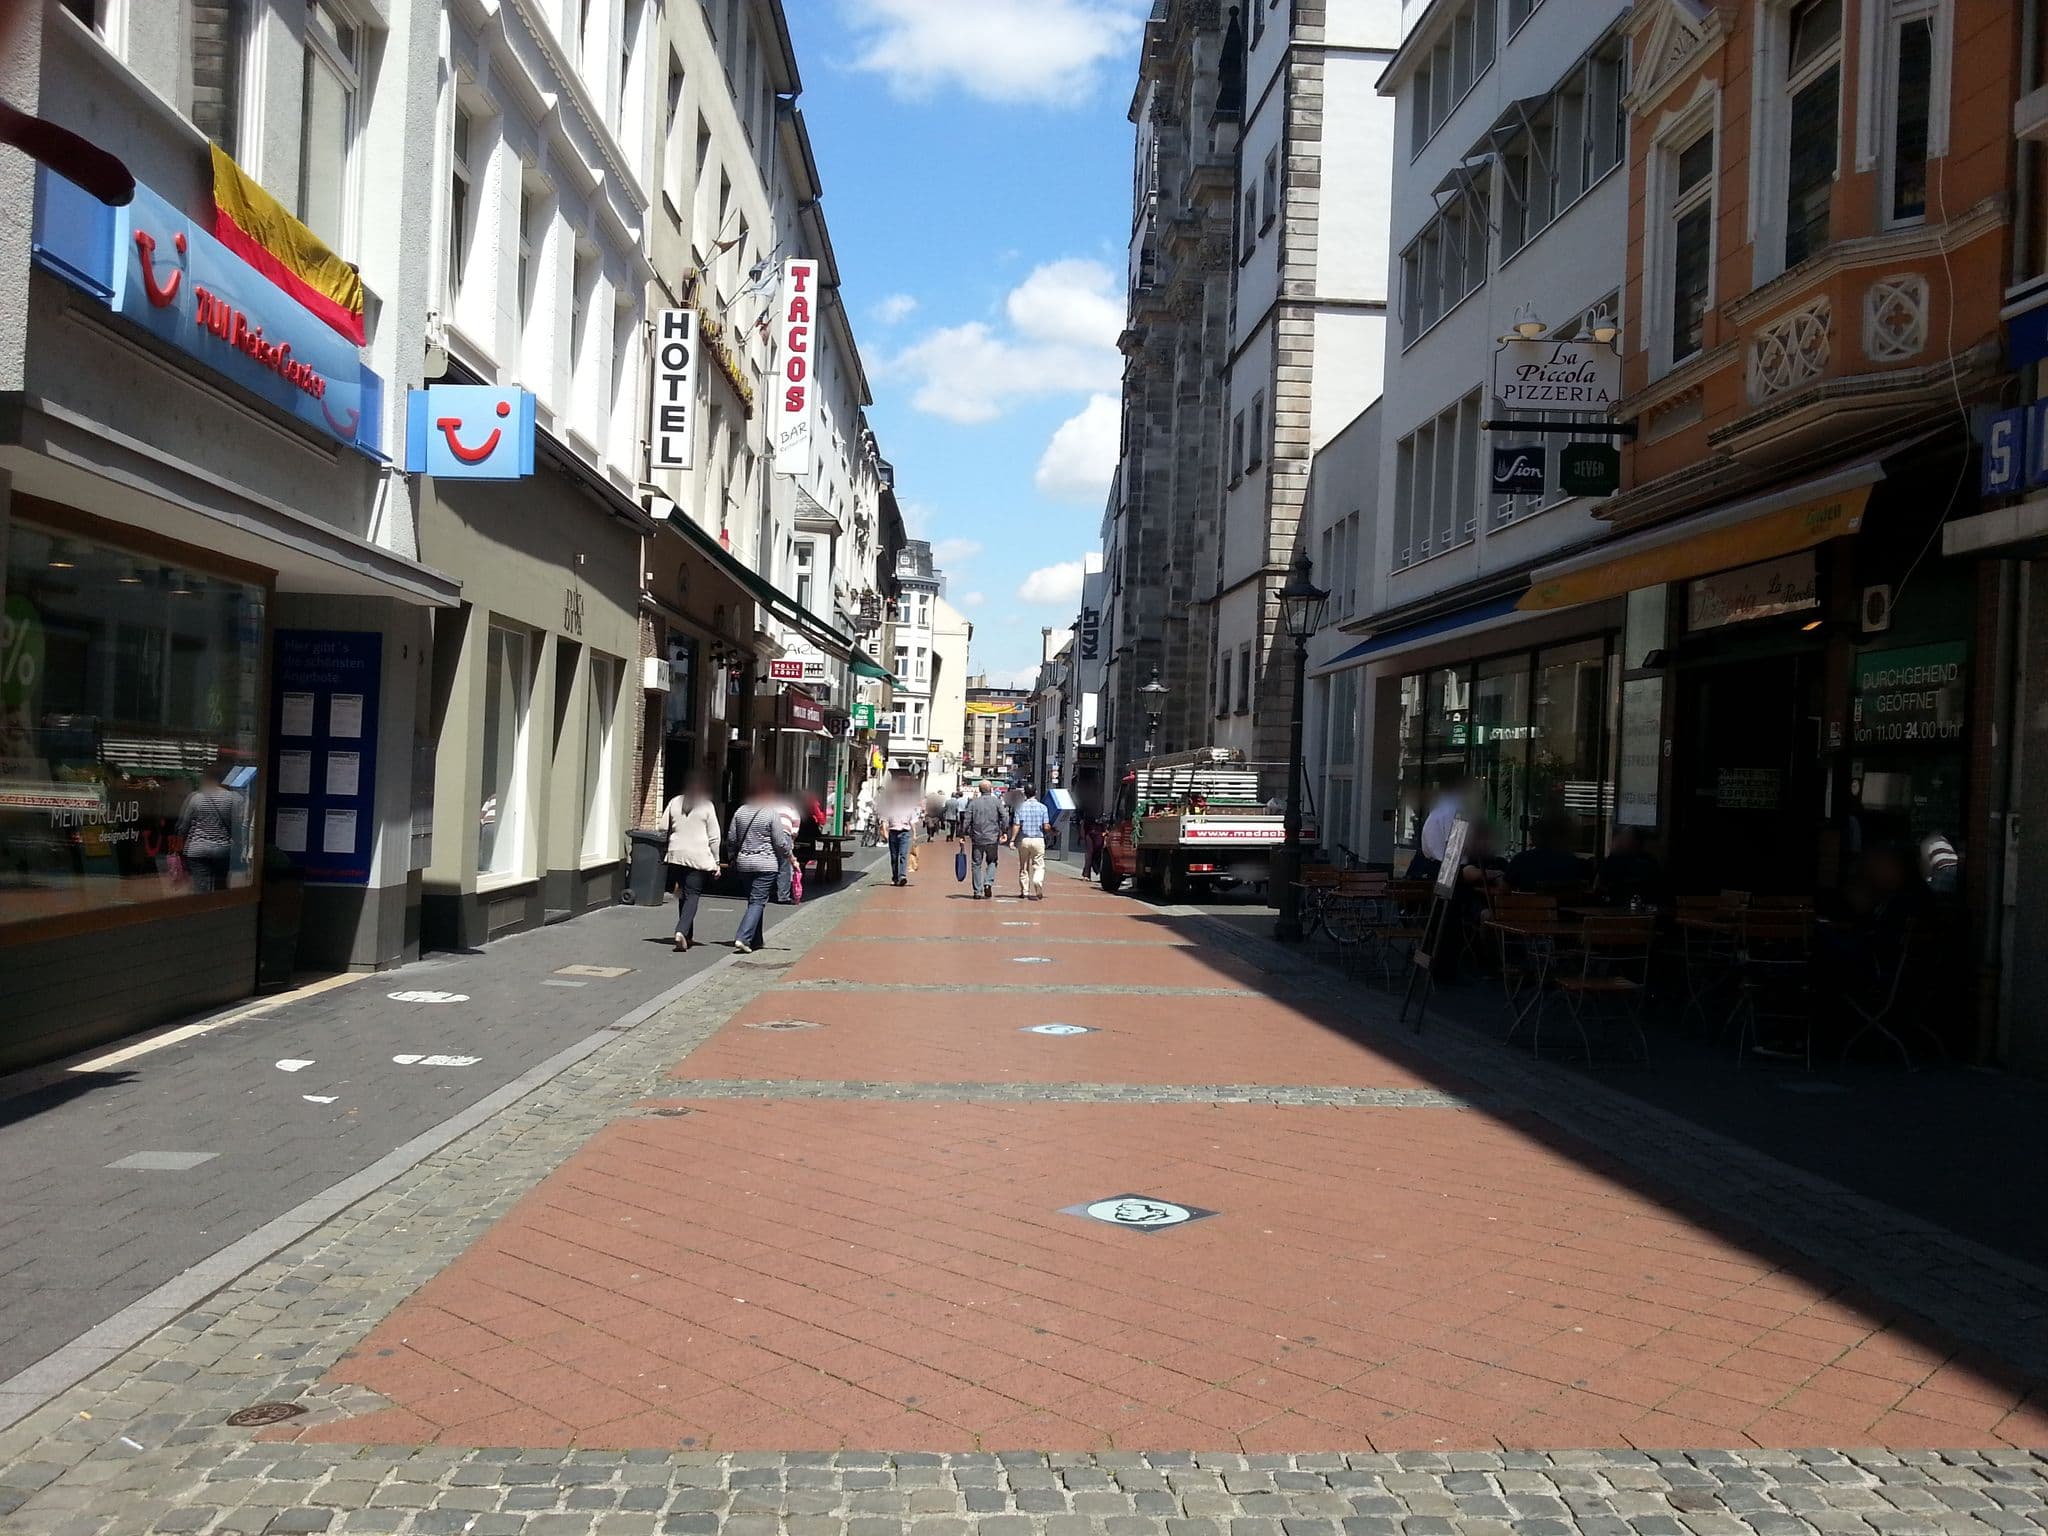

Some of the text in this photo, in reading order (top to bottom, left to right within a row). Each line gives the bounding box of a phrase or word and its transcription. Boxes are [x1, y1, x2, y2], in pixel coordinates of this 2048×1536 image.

[195, 286, 232, 340] TUI
[785, 266, 811, 413] TACOS
[1549, 341, 1578, 365] La
[1516, 360, 1596, 384] Piccola
[660, 311, 690, 464] HOTEL
[1503, 385, 1610, 403] PIZZERIA
[780, 422, 807, 444] BAR
[1494, 455, 1544, 482] Sion
[1082, 606, 1100, 660] KULT
[1862, 663, 1959, 690] DURCHGEHEND
[1876, 690, 1942, 713] GEÖFFNET
[1854, 727, 1873, 741] von
[50, 800, 141, 829] MEIN URLAUB
